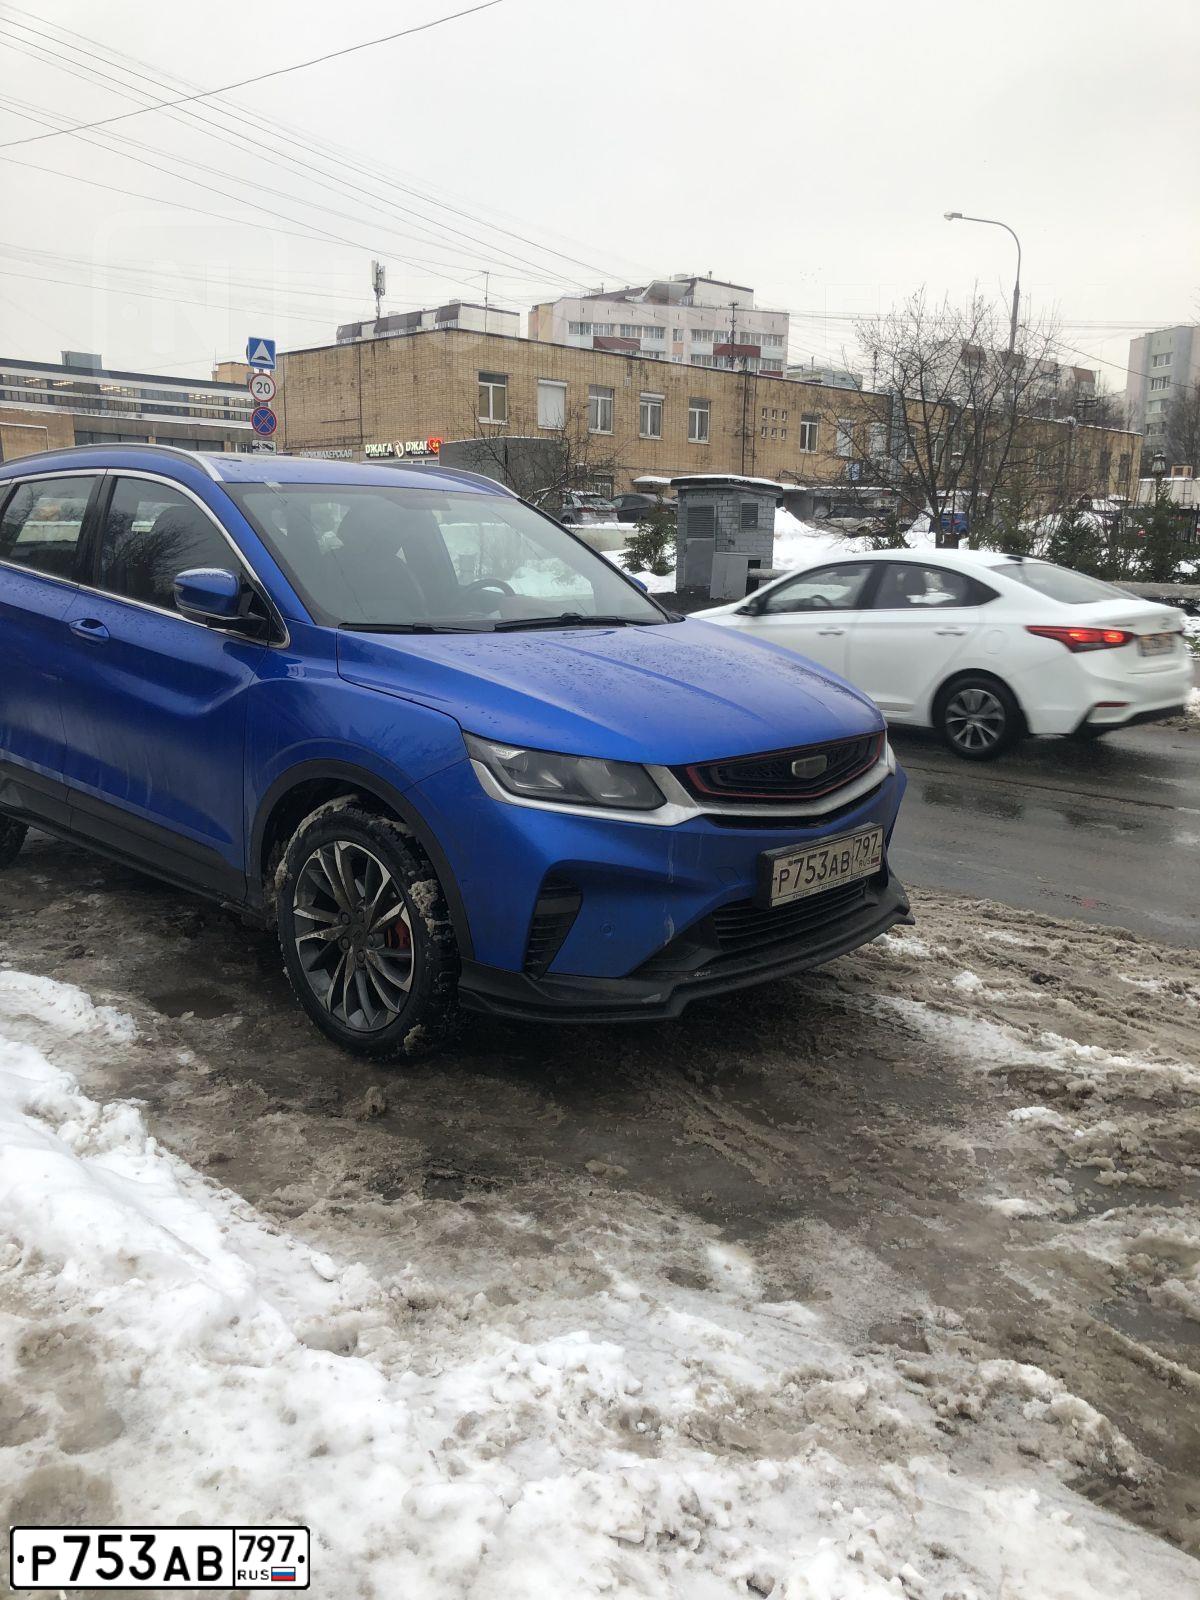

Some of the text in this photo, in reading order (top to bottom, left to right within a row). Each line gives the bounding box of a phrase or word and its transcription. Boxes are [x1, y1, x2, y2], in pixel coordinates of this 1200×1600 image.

[256, 381, 271, 395] 20
[854, 833, 878, 862] 797
[859, 857, 872, 868] RUS
